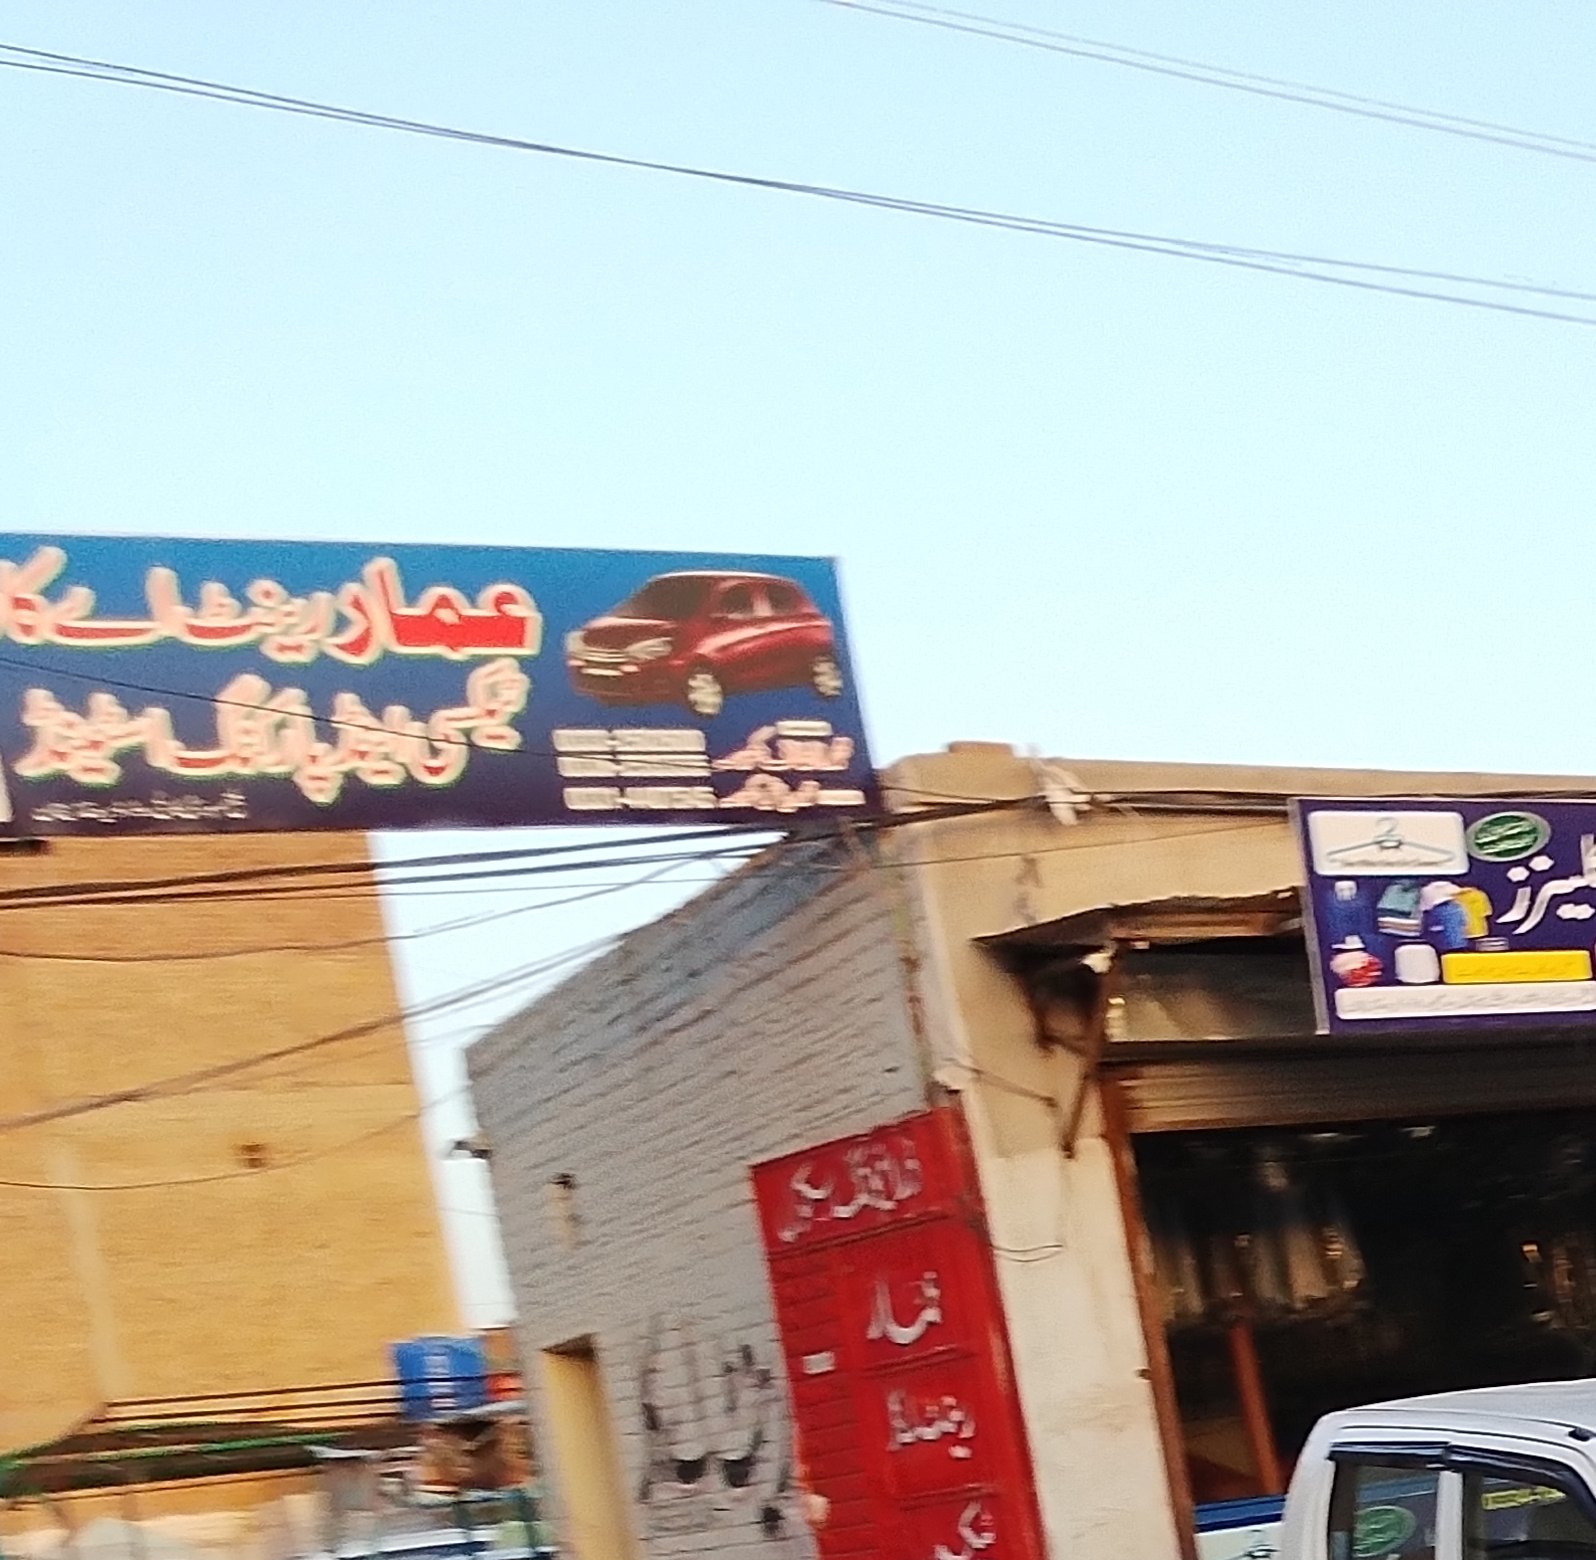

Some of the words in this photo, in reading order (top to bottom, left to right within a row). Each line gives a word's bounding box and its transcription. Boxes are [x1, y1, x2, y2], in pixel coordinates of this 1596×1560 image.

[0, 544, 68, 645] کا
[182, 575, 340, 665] رینٹ
[322, 556, 544, 667] عمار
[1495, 832, 1596, 936] لینرز
